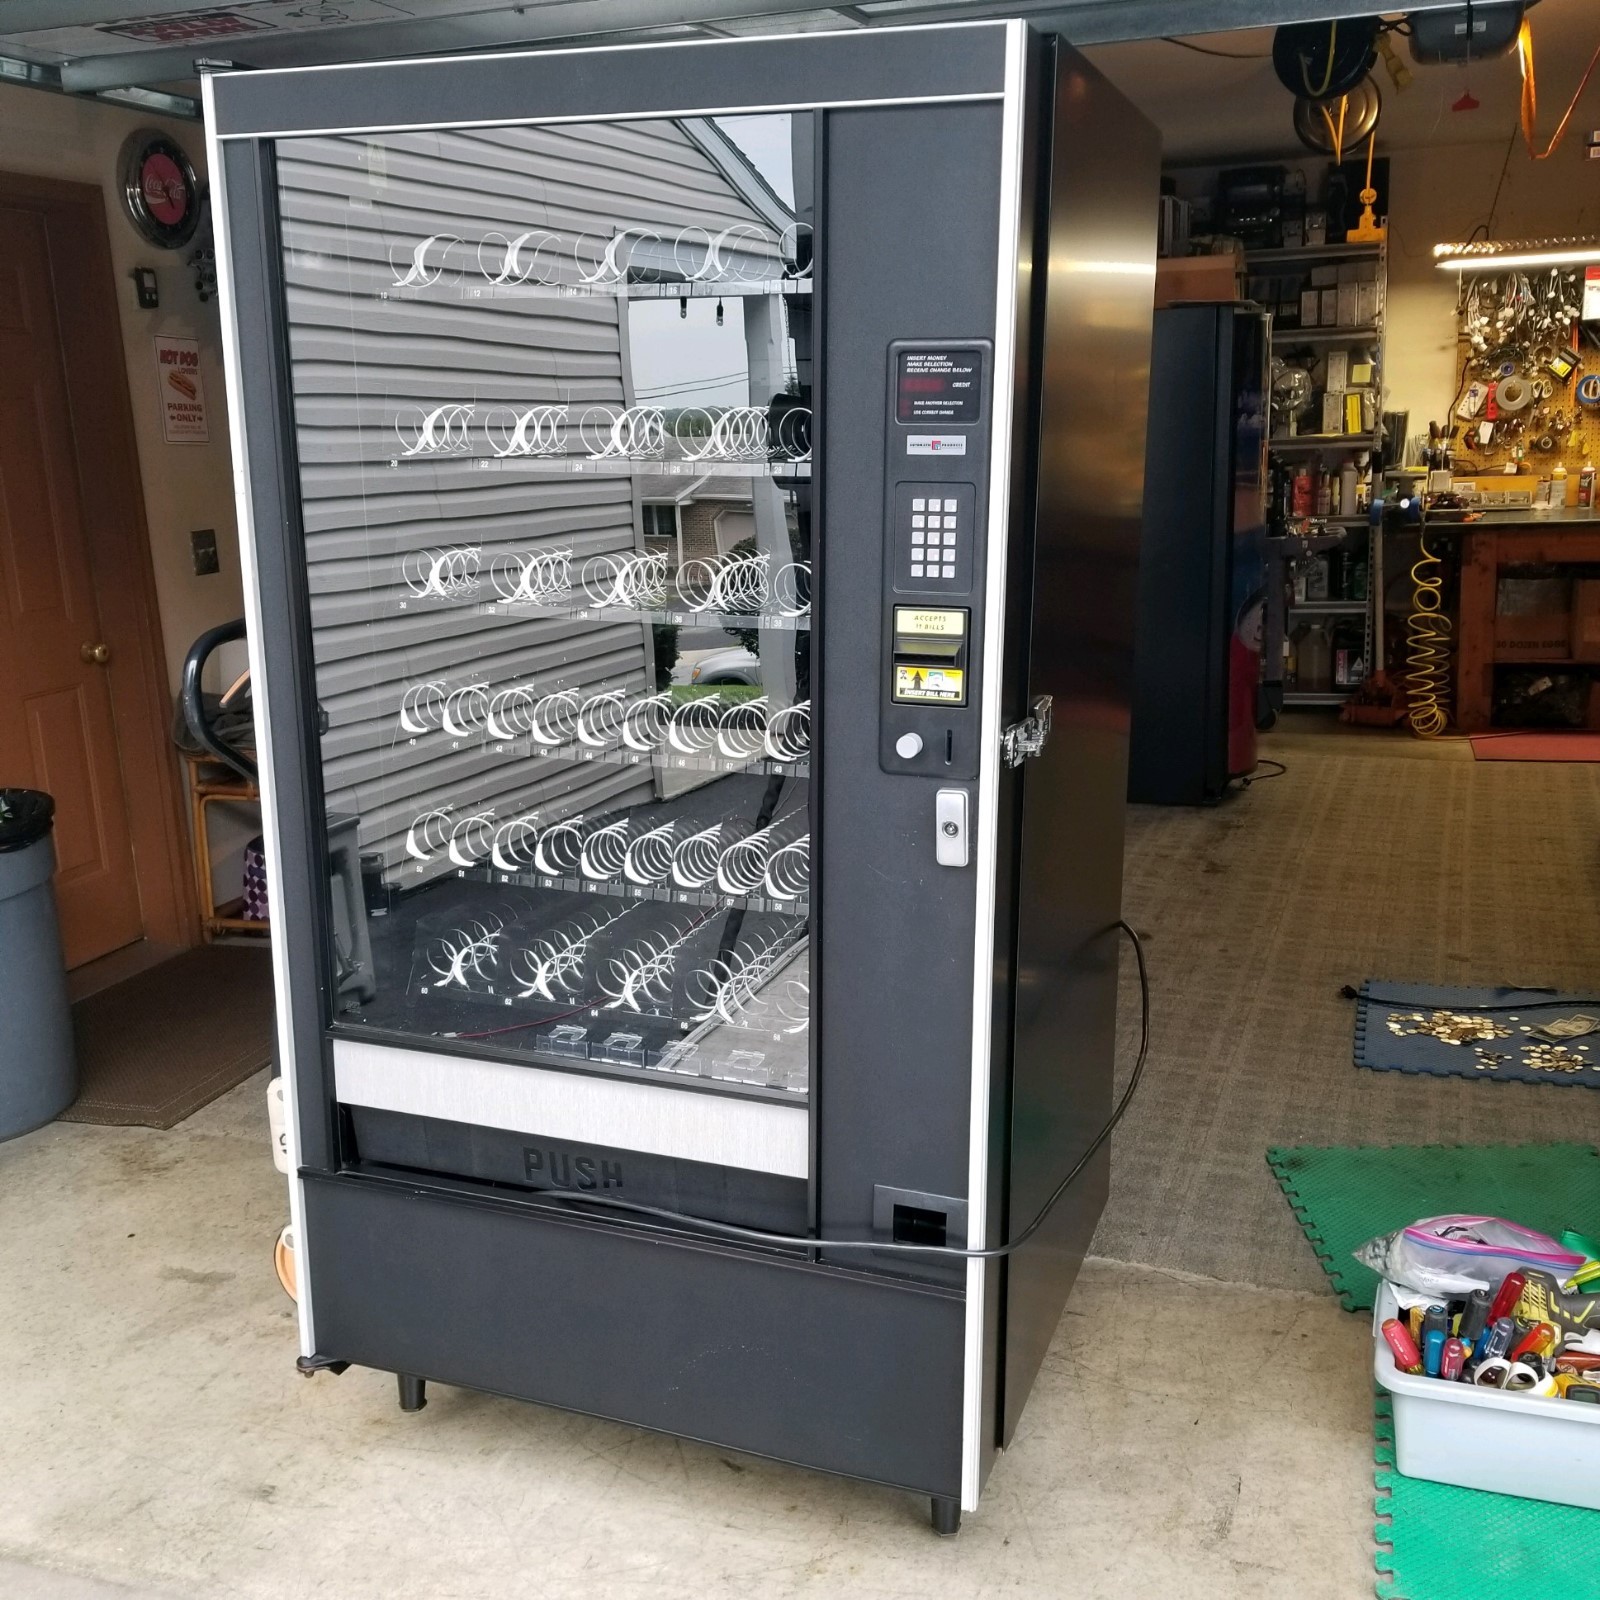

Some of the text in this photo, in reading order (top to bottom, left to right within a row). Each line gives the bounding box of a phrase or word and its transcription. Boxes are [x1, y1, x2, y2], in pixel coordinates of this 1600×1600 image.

[473, 289, 481, 297] 12
[569, 288, 577, 296] 14
[160, 349, 198, 366] HOT DOG
[167, 403, 202, 412] PARKING
[177, 414, 197, 422] ONLY
[480, 460, 489, 468] 22
[575, 463, 583, 471] 24
[488, 606, 496, 614] 32
[580, 610, 588, 618] 34
[1509, 640, 1539, 649] DOZEN
[939, 691, 956, 699] HERE
[409, 738, 417, 746] 40
[452, 741, 459, 749] 41
[495, 744, 503, 753] 42
[540, 748, 548, 756] 43
[585, 752, 593, 760] 44
[631, 755, 639, 763] 45
[678, 758, 686, 767] 46
[725, 762, 734, 770] 47
[774, 765, 783, 773] 48
[416, 865, 423, 873] 50
[458, 869, 465, 878] 51
[501, 874, 509, 882] 52
[545, 879, 553, 887] 53
[589, 884, 597, 892] 54
[634, 888, 642, 897] 55
[679, 893, 688, 902] 56
[726, 898, 735, 906] 57
[774, 902, 783, 911] 58
[504, 997, 512, 1006] 62
[590, 1009, 599, 1017] 64
[680, 1021, 689, 1030] 66
[522, 1146, 623, 1194] PUSH
